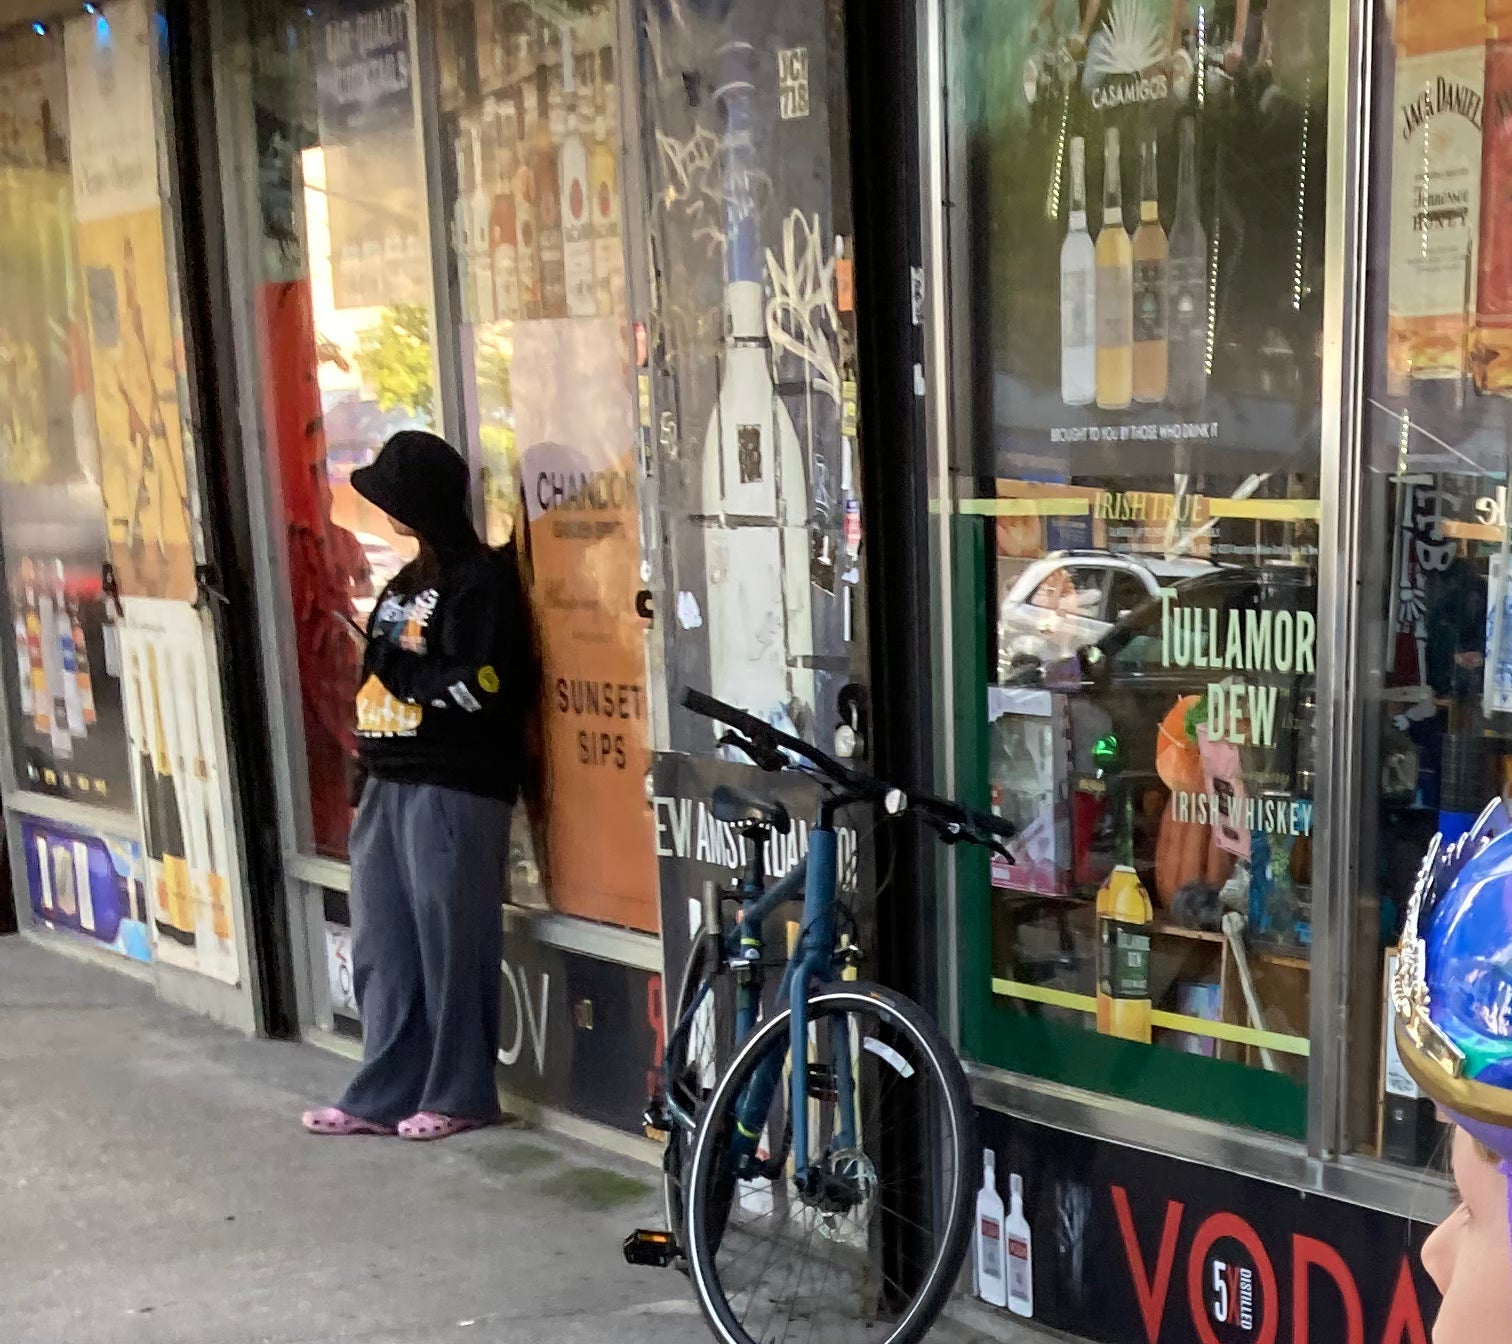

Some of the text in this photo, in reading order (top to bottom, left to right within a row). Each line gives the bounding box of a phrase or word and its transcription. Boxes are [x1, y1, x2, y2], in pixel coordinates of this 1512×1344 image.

[1091, 75, 1168, 109] CASAMIGOS
[1403, 92, 1435, 141] JACK
[1051, 427, 1088, 442] BROUGHT
[1089, 427, 1099, 441] TO
[1131, 425, 1158, 440] THOSE
[1159, 424, 1181, 439] WHO
[1093, 492, 1147, 521] IRISH
[1159, 588, 1316, 673] TULLAMOR
[556, 678, 642, 720] SUNSET
[579, 729, 627, 769] SIPS
[1171, 791, 1313, 836] IRISH WHISKEY
[697, 802, 808, 878] AMSTDA
[1240, 1268, 1253, 1331] DISTILLED
